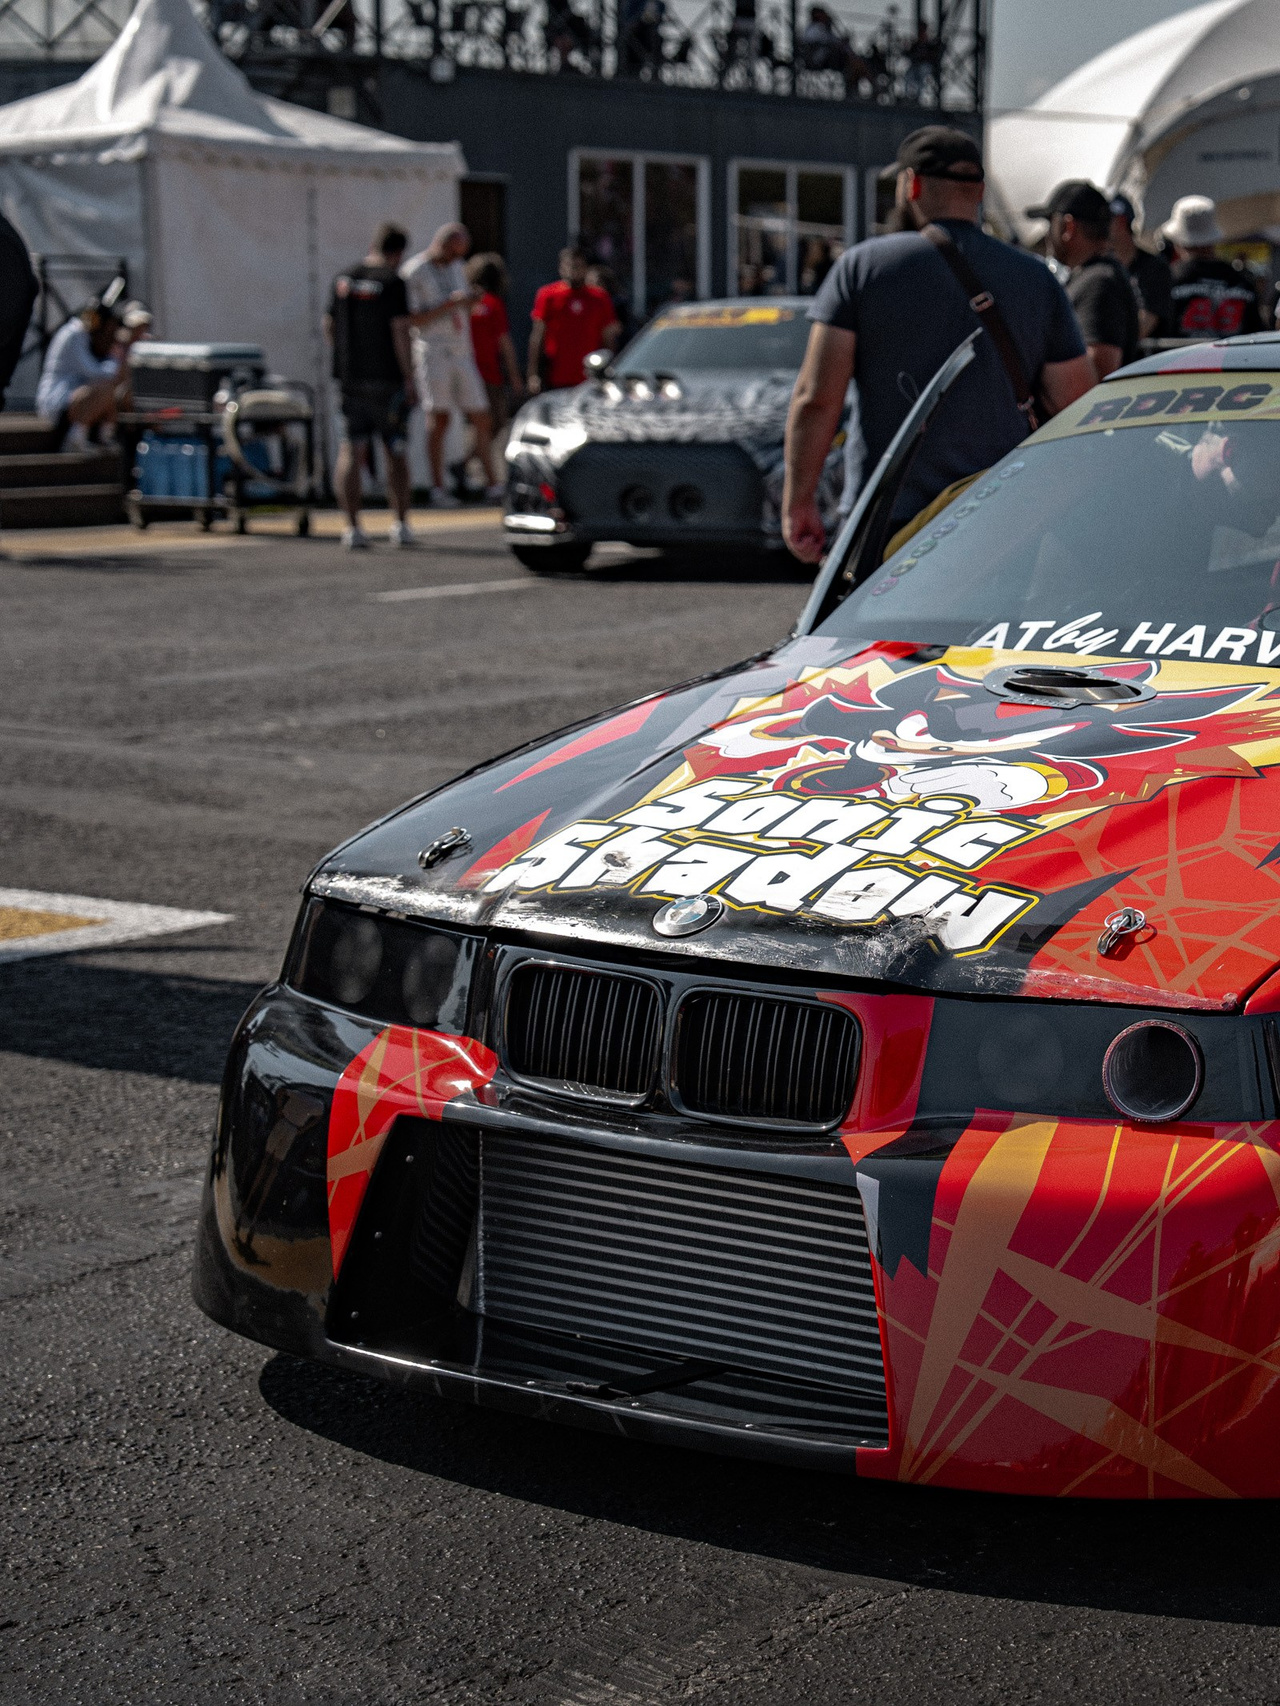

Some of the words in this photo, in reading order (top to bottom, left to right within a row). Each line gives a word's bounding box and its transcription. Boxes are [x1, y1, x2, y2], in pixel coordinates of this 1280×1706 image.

[1076, 383, 1274, 428] RDRC
[969, 620, 1056, 652] AT
[1041, 611, 1120, 656] by
[613, 777, 1034, 870] Sonic
[482, 823, 1032, 952] Shadow
